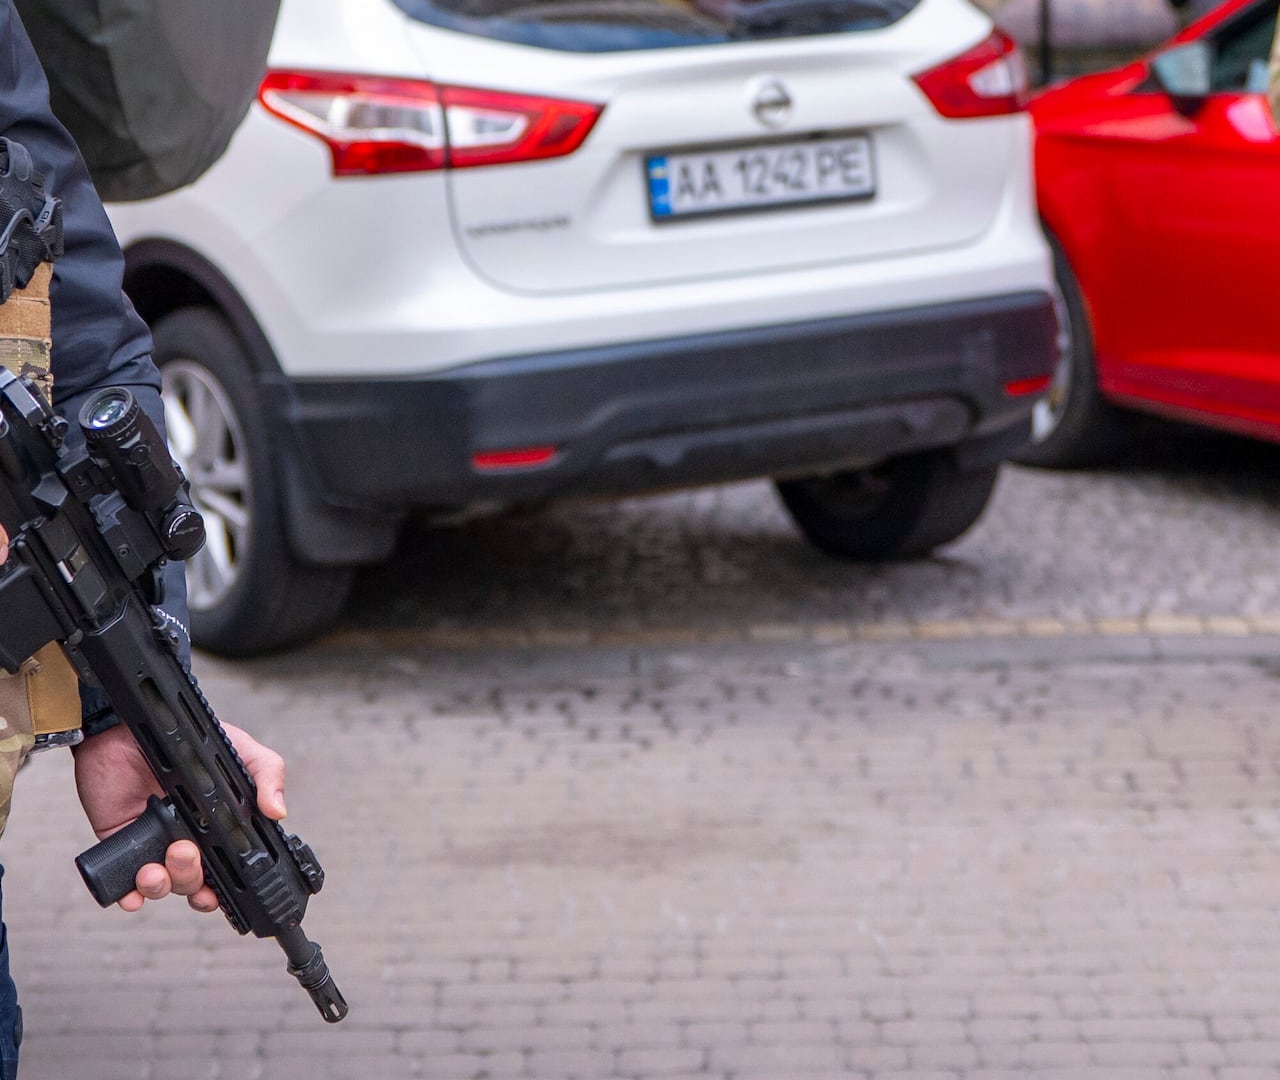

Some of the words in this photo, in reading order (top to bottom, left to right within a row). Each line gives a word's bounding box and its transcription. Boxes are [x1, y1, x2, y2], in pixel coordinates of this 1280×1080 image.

[677, 160, 724, 201] AA
[735, 146, 808, 195] 1242
[816, 141, 864, 188] PE
